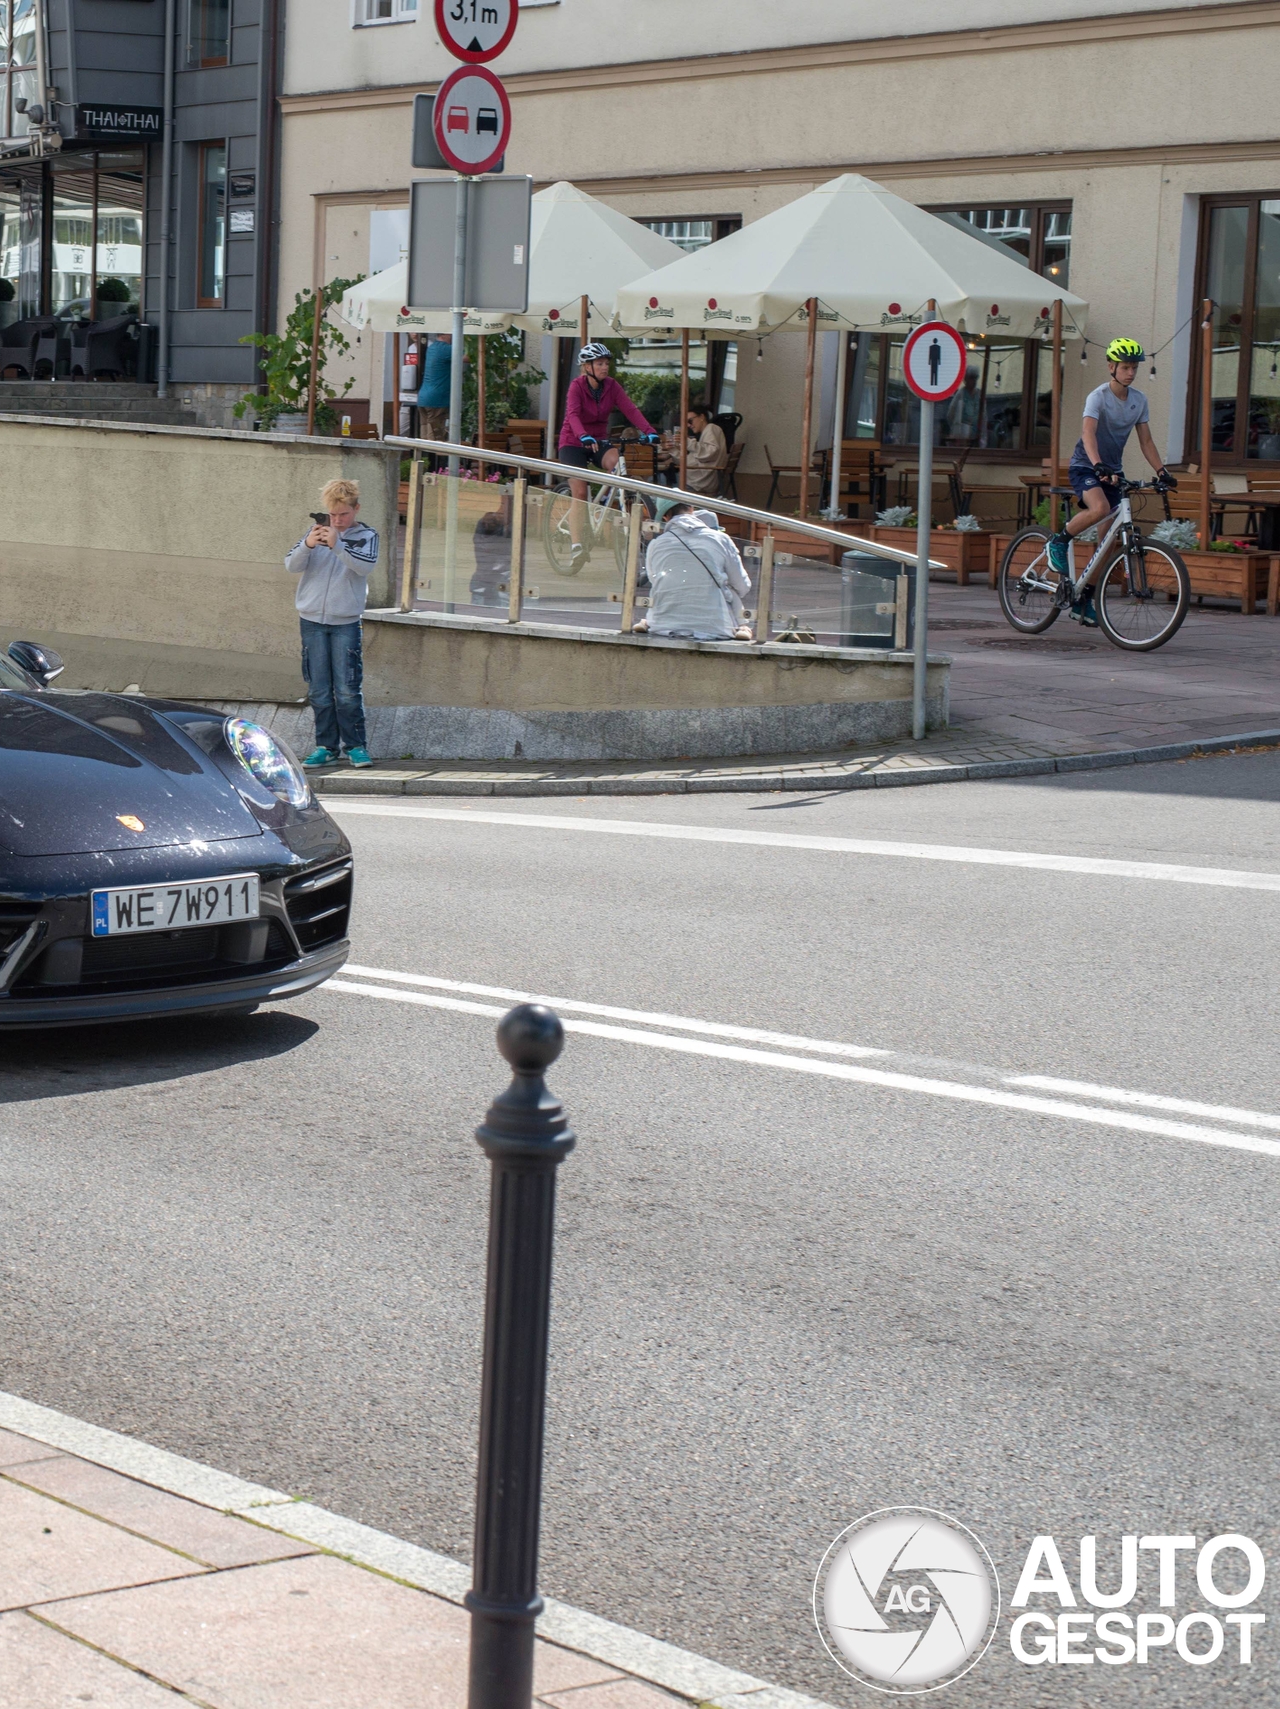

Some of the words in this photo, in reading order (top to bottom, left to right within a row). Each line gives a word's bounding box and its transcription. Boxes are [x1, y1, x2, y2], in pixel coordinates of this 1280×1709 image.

[83, 110, 118, 127] THAI
[124, 112, 159, 129] THAI
[116, 893, 154, 929] WE
[167, 881, 250, 926] 7W911
[96, 918, 107, 928] PL
